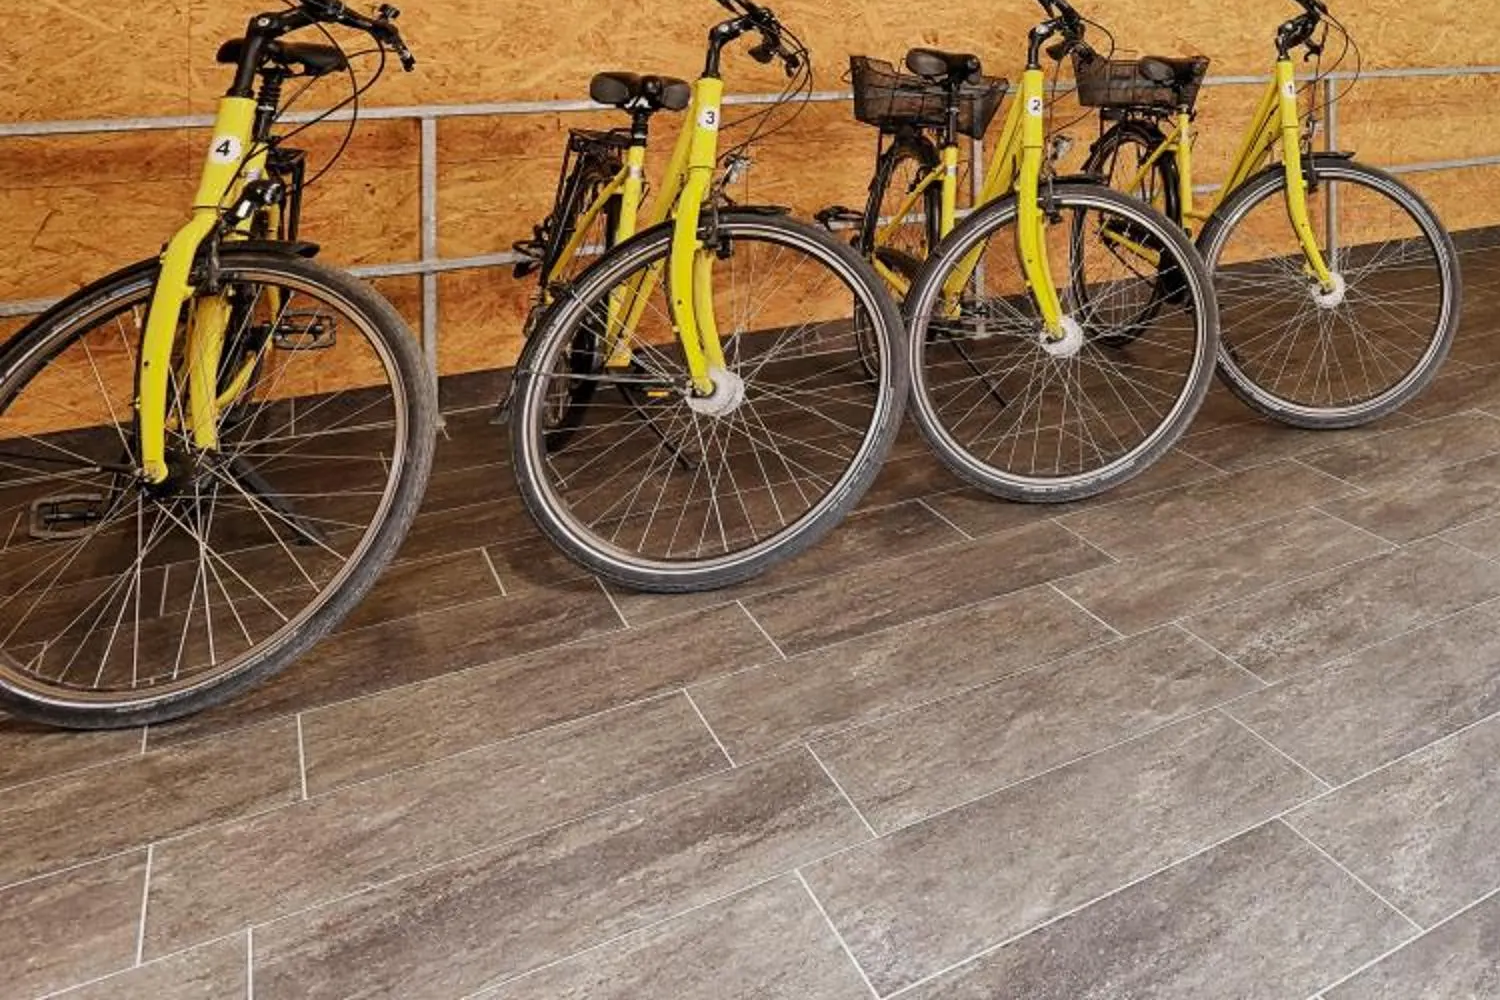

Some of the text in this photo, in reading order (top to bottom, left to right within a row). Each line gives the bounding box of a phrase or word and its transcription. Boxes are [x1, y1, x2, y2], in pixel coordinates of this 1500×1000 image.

[1287, 85, 1293, 94] 1
[1032, 99, 1041, 111] 2
[705, 111, 715, 125] 3
[215, 139, 231, 156] 4
